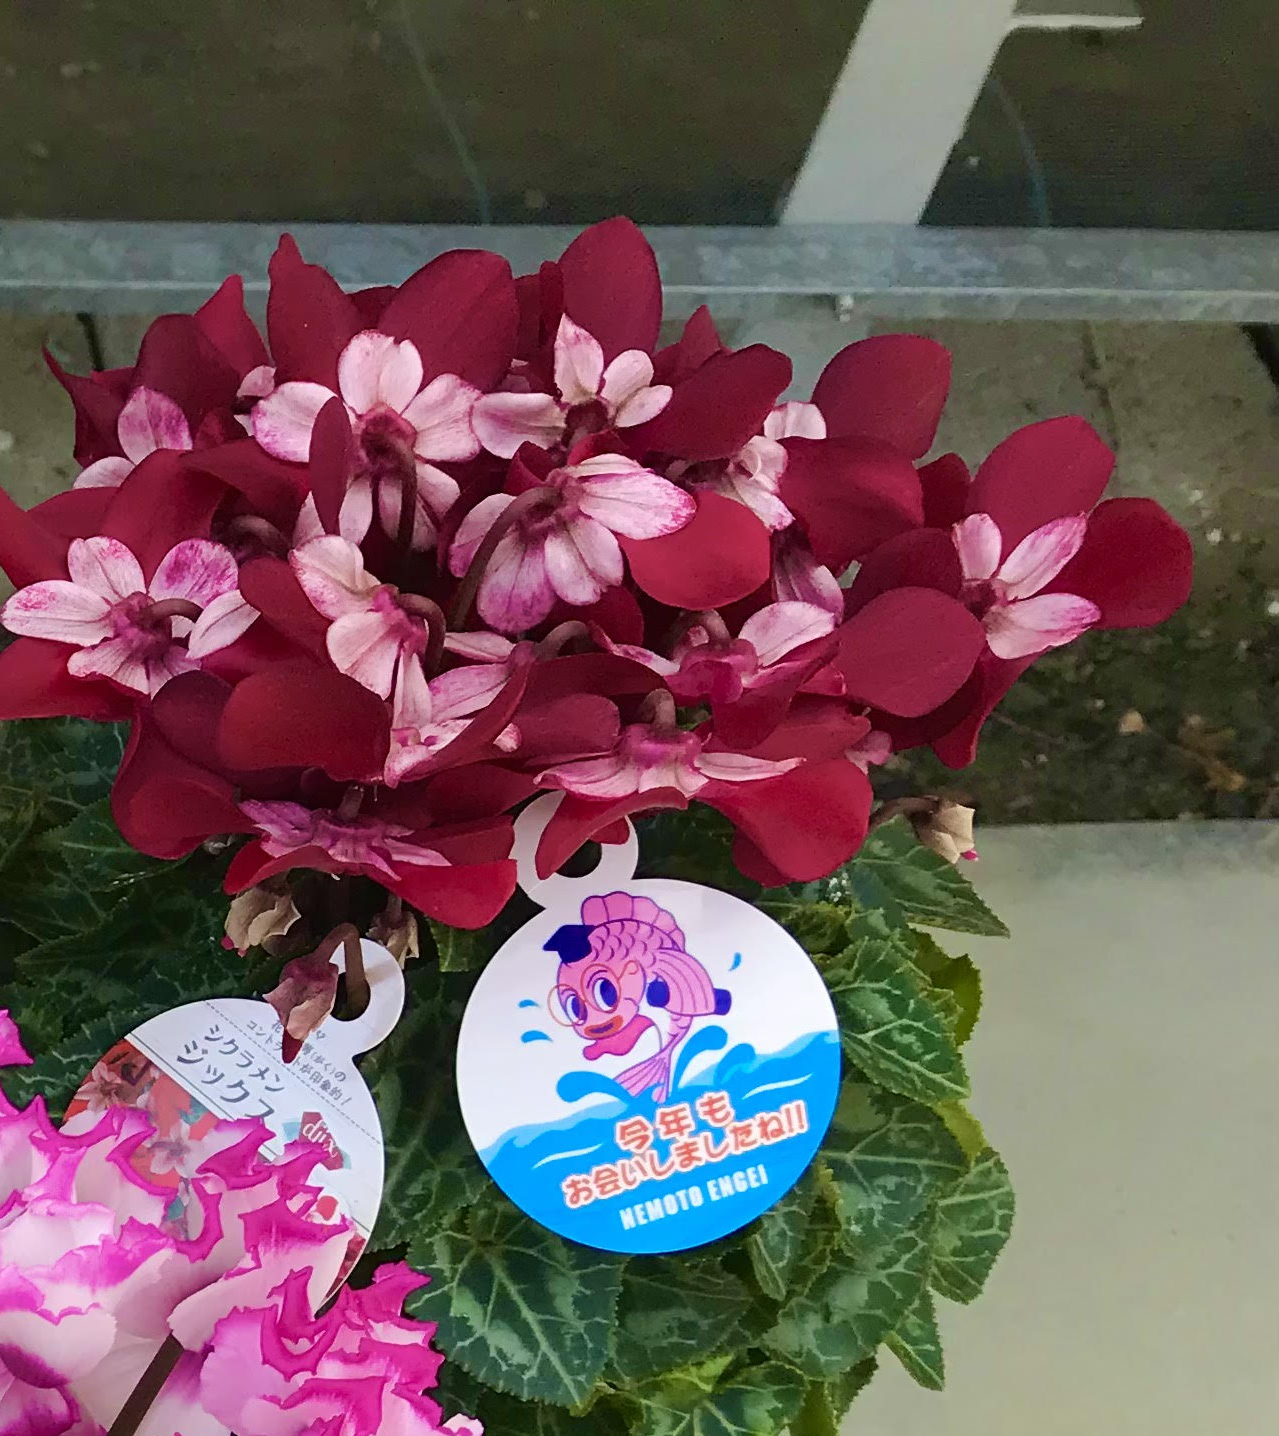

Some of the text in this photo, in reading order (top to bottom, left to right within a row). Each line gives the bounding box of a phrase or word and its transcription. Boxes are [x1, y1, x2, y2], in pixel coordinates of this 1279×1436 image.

[177, 1040, 275, 1118] ジックス
[205, 1025, 285, 1092] シクラメン
[615, 1091, 734, 1153] 今年も
[619, 1163, 769, 1231] NEMOTO ENGEI
